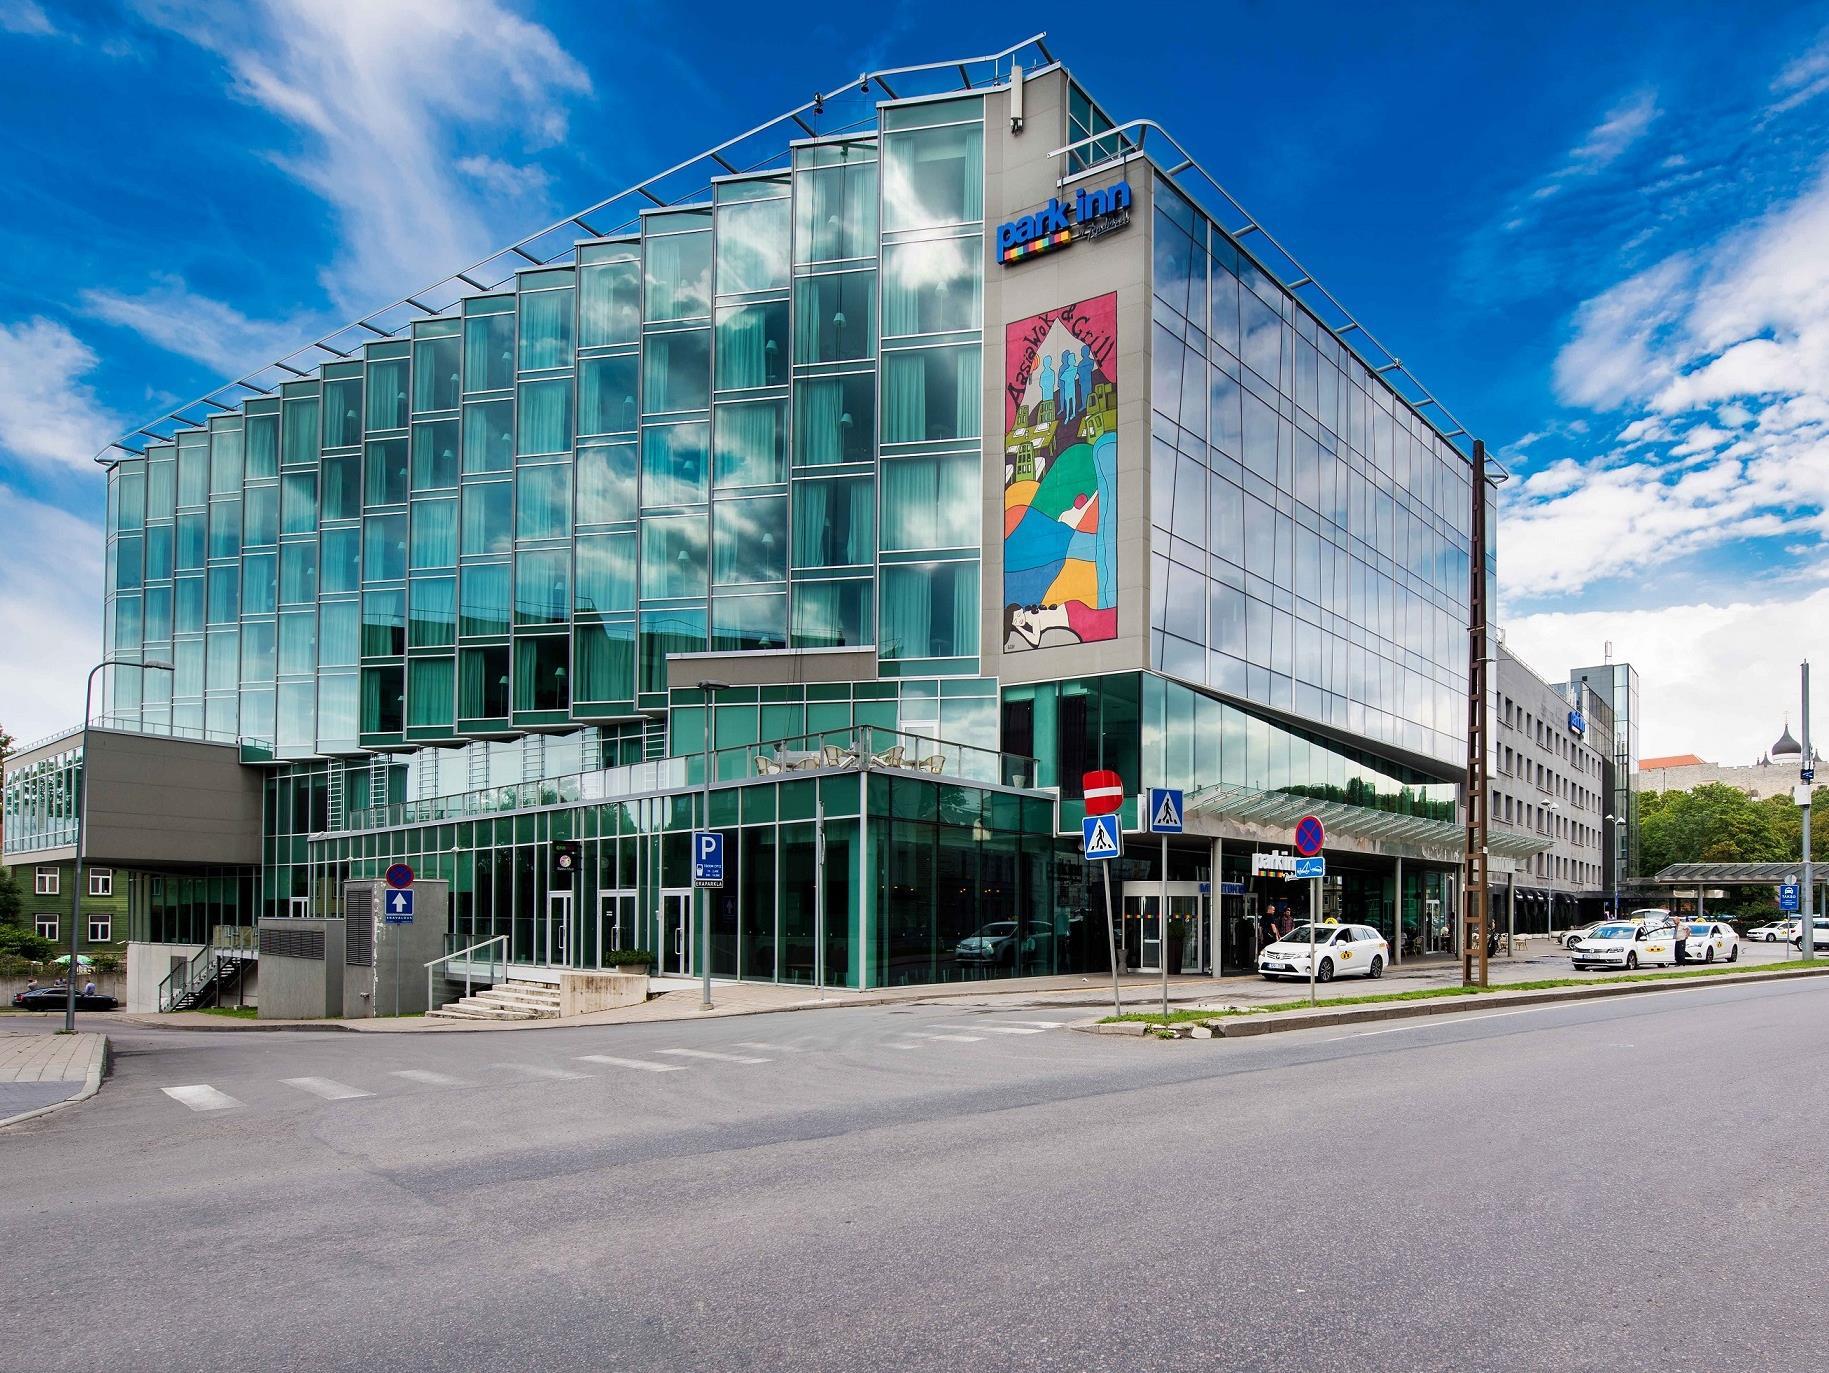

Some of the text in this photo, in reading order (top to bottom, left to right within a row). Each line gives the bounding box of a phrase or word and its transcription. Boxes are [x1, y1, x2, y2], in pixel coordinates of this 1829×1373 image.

[996, 180, 1132, 265] park inn
[1007, 346, 1037, 408] Aasia
[1061, 304, 1077, 322] &
[1071, 315, 1115, 368] Grill
[701, 836, 716, 860] P
